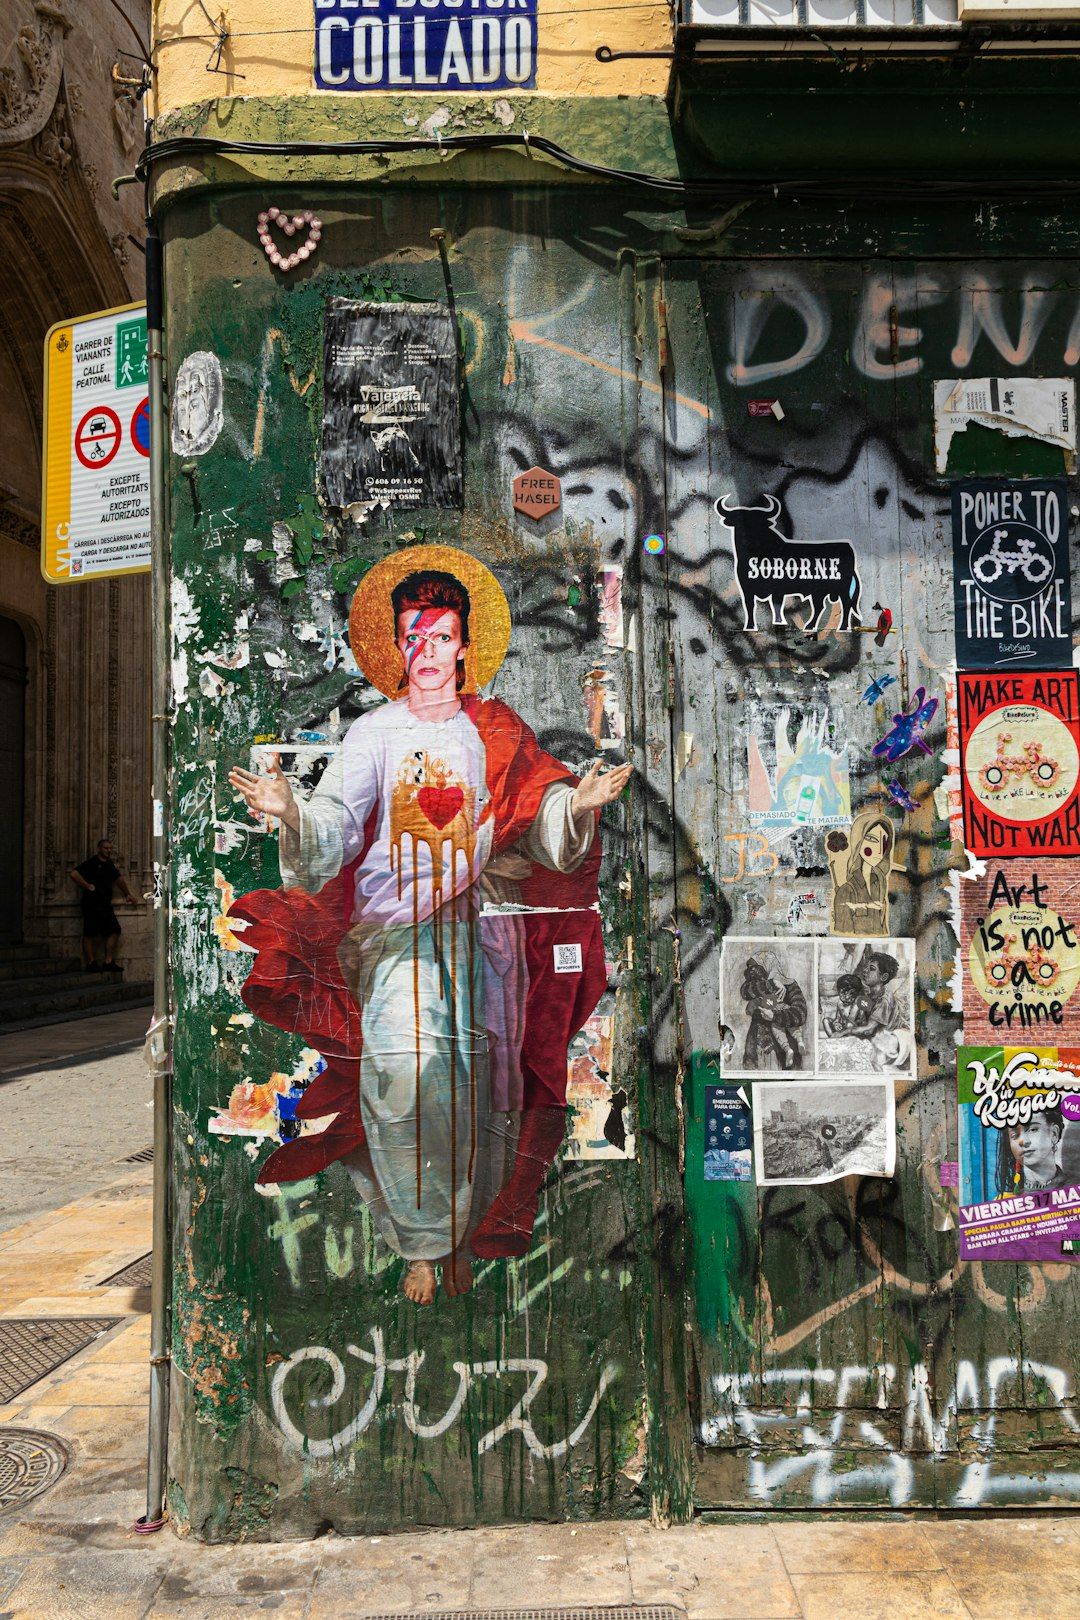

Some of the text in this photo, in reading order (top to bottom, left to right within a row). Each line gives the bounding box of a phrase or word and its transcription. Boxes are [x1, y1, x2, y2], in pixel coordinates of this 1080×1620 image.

[318, 15, 532, 85] COLLADO
[75, 336, 113, 353] CARRER DE
[76, 347, 111, 363] VIANANTS
[76, 373, 111, 389] PEATONAL
[83, 363, 105, 377] CALLE
[360, 389, 421, 402] Valencia
[1060, 391, 1069, 432] MASTER
[101, 483, 149, 499] AUTORITZATS
[109, 473, 140, 487] EXCEPTE
[521, 478, 554, 489] FREE
[109, 498, 141, 511] EXCEPTO
[515, 493, 558, 504] HASEL
[100, 507, 150, 523] AUTORIZADOS
[960, 491, 1060, 545] POWER TO
[81, 549, 97, 557] CARGA
[103, 544, 129, 554] DESCARGA
[748, 557, 841, 580] SOBORNE
[960, 578, 1069, 638] THE BIKE
[963, 678, 1075, 732] MAKE ART
[749, 811, 797, 819] DEMASIADO
[969, 796, 1080, 848] NOT WAR
[988, 870, 1048, 910] Art
[977, 916, 1077, 952] is not
[1011, 961, 1037, 987] a
[988, 993, 1063, 1028] crime
[1000, 1085, 1014, 1100] in
[973, 1090, 1061, 1129] Reggae
[1064, 1101, 1080, 1113] Vol.
[961, 1195, 1035, 1222] VIERNES
[1035, 1193, 1050, 1207] 17
[964, 1226, 990, 1236] SPECIAL
[990, 1222, 1011, 1231] PAULA
[1011, 1219, 1026, 1227] BAM
[1026, 1216, 1041, 1225] BAM
[1041, 1210, 1073, 1221] BIRTHDAY
[970, 1231, 1000, 1242] BARBARA
[1000, 1224, 1031, 1236] GRAMAGE
[1037, 1219, 1057, 1229] NDUMI
[1058, 1214, 1078, 1224] BLACK
[967, 1242, 982, 1250] BAM
[983, 1239, 997, 1247] BAM
[998, 1236, 1009, 1244] ALL
[1010, 1232, 1030, 1241] STARS
[1035, 1224, 1069, 1237] INVITADOS
